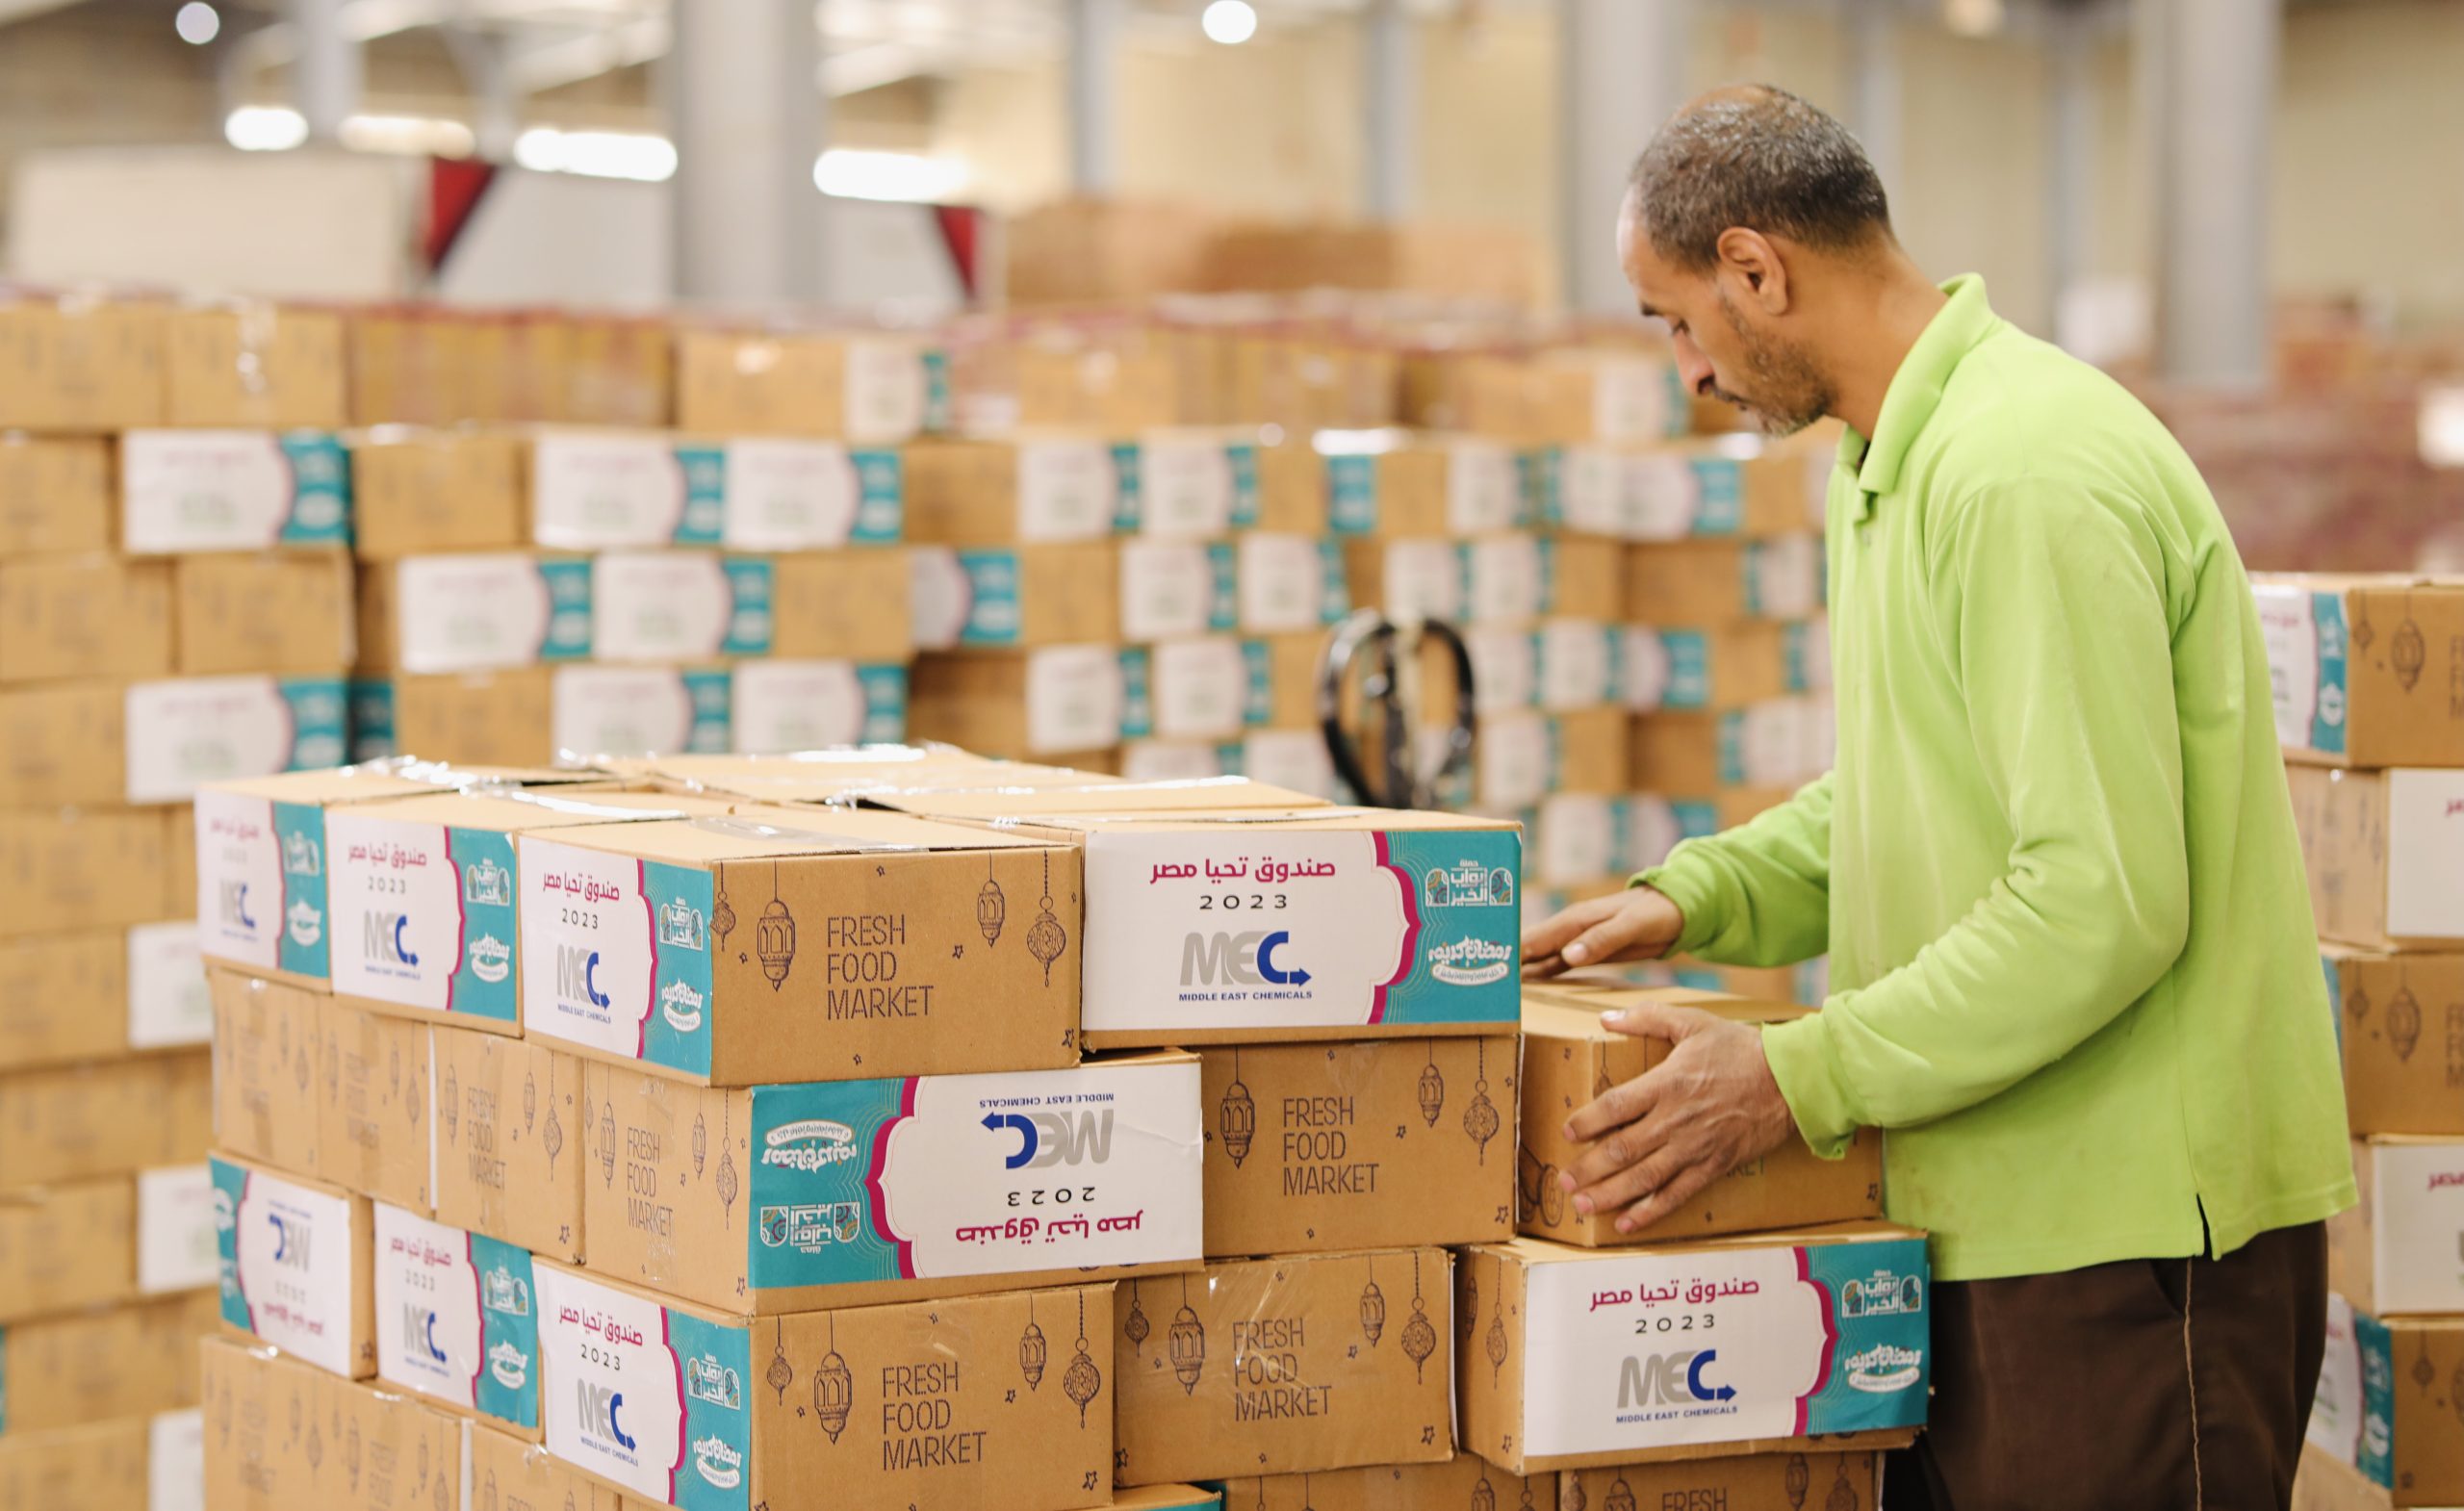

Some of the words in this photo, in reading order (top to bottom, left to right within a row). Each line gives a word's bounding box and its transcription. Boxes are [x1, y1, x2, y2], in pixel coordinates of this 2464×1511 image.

[543, 871, 562, 892] مصر
[564, 870, 584, 899] تحيا
[1149, 862, 1198, 885] مصر
[1205, 856, 1249, 884] تحيا
[1254, 856, 1336, 884] صندوق
[583, 873, 621, 903] صندوق
[1199, 894, 1288, 910] 2023
[561, 908, 600, 931] 2023
[827, 913, 906, 948] FRESH
[364, 909, 408, 965] MEC
[827, 951, 898, 985] FOOD
[1179, 931, 1290, 986] MEC
[556, 943, 601, 1007] MEC
[827, 985, 935, 1021] MARKET
[1178, 992, 1219, 1002] MIDDLE
[1220, 992, 1248, 1001] EAST
[1252, 990, 1313, 1000] CHEMICALS
[979, 1096, 1041, 1109] CHEMICALS
[1045, 1095, 1073, 1105] EAST
[1075, 1093, 1115, 1104] MIDDLE
[1283, 1095, 1354, 1129] FRESH
[627, 1127, 660, 1164] FRESH
[1006, 1110, 1115, 1170] MEC
[1283, 1130, 1347, 1163] FOOD
[627, 1162, 657, 1198] FOOD
[1283, 1163, 1380, 1197] MARKET
[1006, 1186, 1095, 1208] 2023
[628, 1196, 674, 1238] MARKET
[955, 1216, 1040, 1245] صندوق
[1046, 1213, 1091, 1242] تحيا
[1096, 1209, 1144, 1234] مصر
[1589, 1288, 1633, 1313] مصر
[1639, 1279, 1680, 1308] تحيا
[1685, 1277, 1760, 1304] صندوق
[559, 1304, 579, 1324] مصر
[582, 1308, 603, 1334] تحيا
[1635, 1314, 1715, 1334] 2023
[604, 1315, 643, 1346] صندوق
[1232, 1317, 1305, 1351] FRESH
[581, 1344, 621, 1370] 2023
[1234, 1353, 1298, 1387] FOOD
[882, 1361, 959, 1398] FRESH
[1617, 1349, 1716, 1409] MEC
[578, 1378, 627, 1447] MEC
[883, 1399, 951, 1434] FOOD
[1235, 1385, 1332, 1422] MARKET
[1616, 1412, 1653, 1423] MIDDLE
[1655, 1412, 1680, 1421] EAST
[1683, 1406, 1738, 1418] CHEMICALS
[883, 1431, 988, 1472] MARKET
